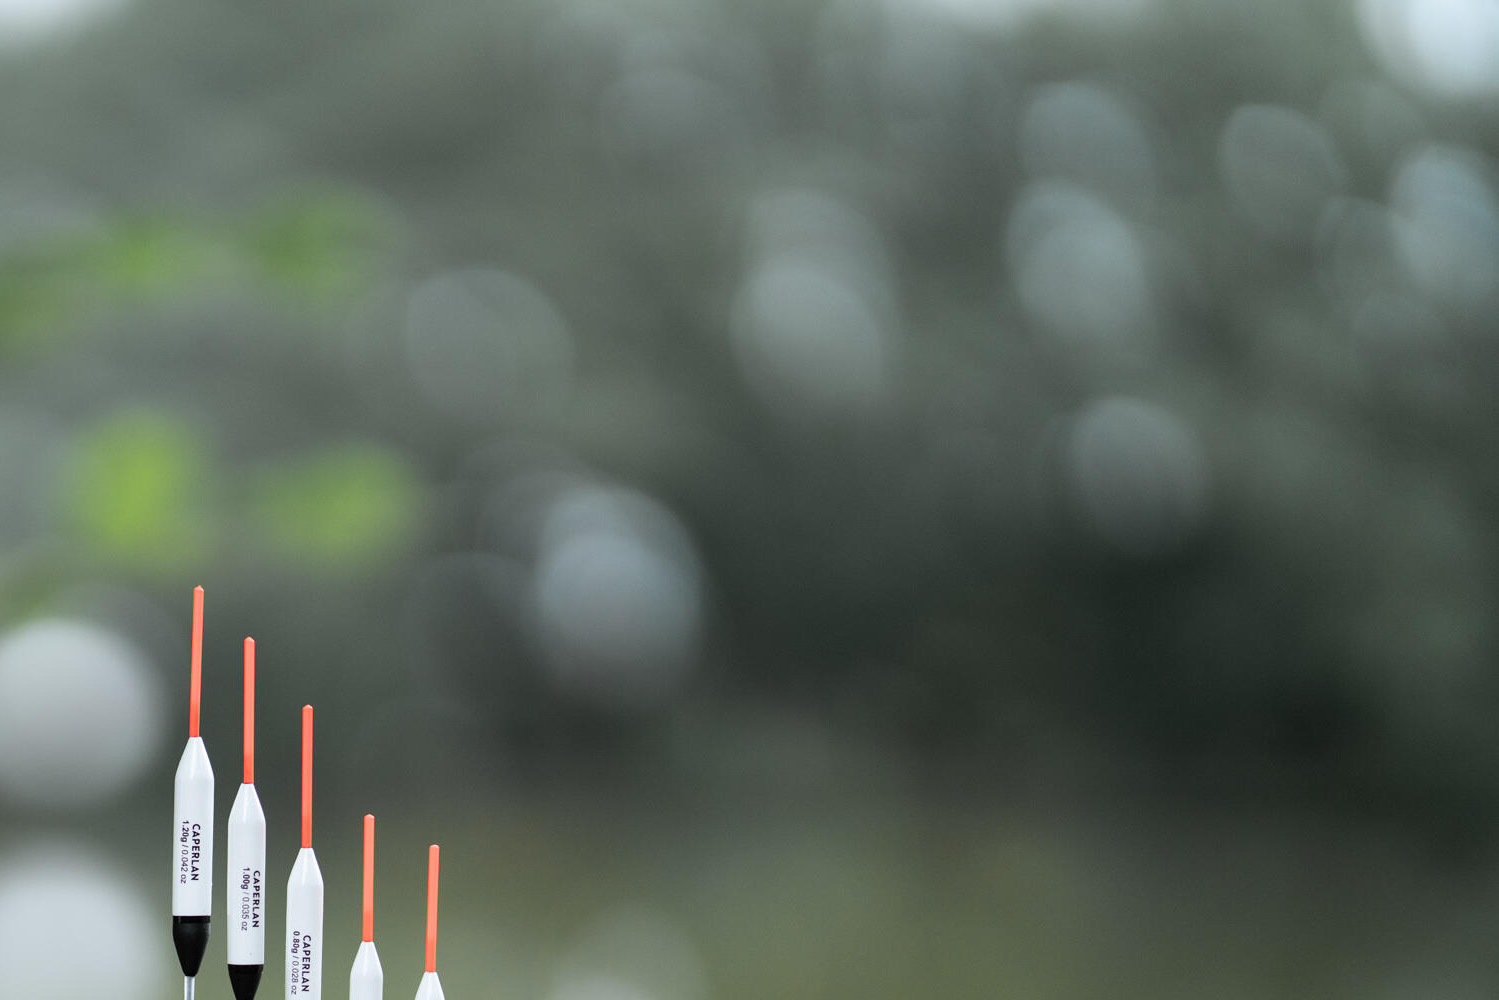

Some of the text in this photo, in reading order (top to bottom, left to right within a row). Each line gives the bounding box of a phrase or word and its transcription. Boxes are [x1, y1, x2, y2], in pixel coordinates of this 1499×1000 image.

[181, 820, 189, 843] 1.20g
[181, 849, 189, 873] 0.042
[191, 823, 201, 881] CAPERLAN
[180, 874, 187, 884] oz
[241, 867, 250, 890] 1.00g
[242, 896, 250, 920] 0.035
[252, 870, 261, 928] CAPERLAN
[241, 921, 248, 931] oz
[291, 930, 300, 954] 0.80g
[291, 960, 299, 983] 0.028
[301, 934, 312, 992] CAPERLAN
[290, 985, 297, 995] oz
